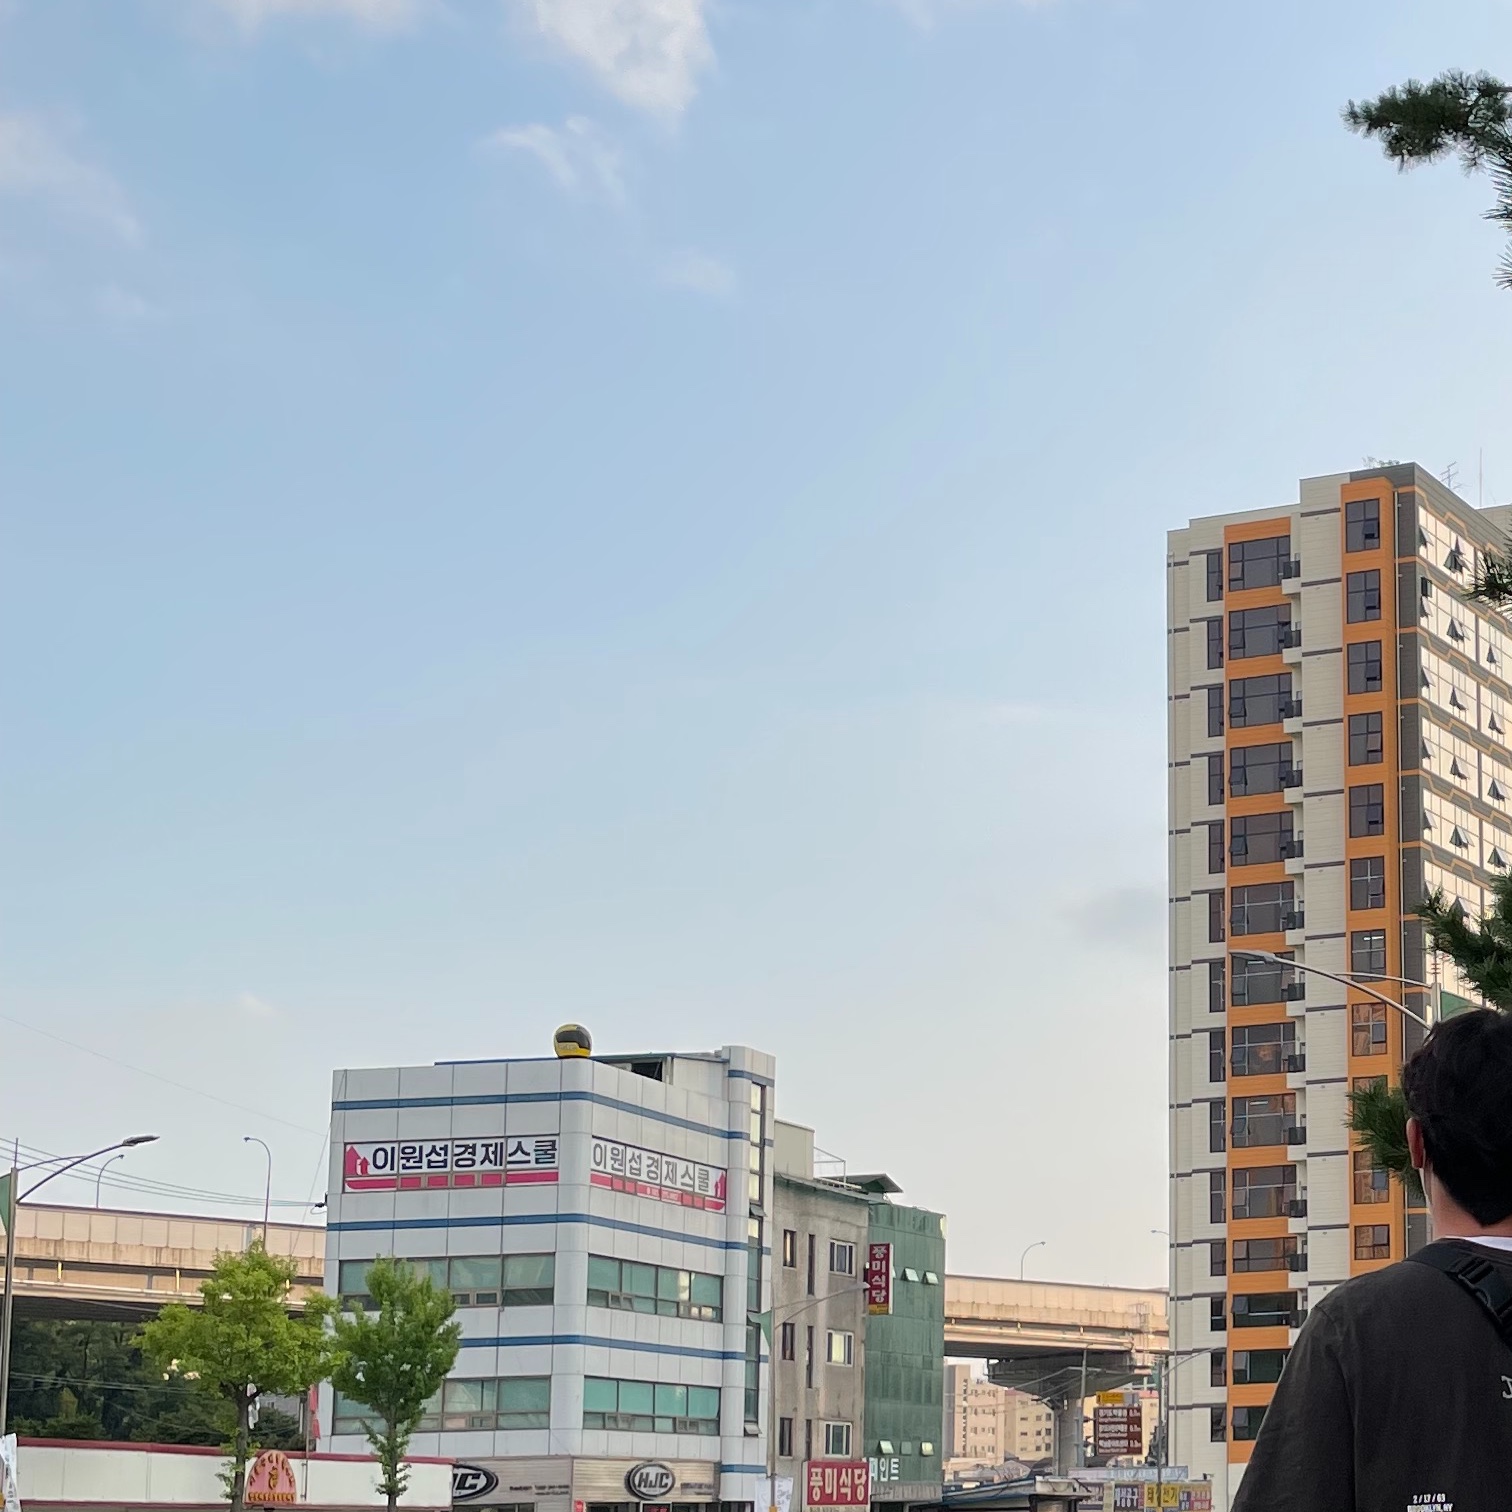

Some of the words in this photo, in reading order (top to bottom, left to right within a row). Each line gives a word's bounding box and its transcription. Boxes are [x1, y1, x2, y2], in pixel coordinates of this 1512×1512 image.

[372, 1138, 558, 1173] 이원섭경제스쿨
[592, 1141, 711, 1193] 이원섭경제스쿨
[871, 1245, 888, 1303] 풍미식당
[637, 1472, 670, 1488] HJC
[810, 1467, 867, 1501] 풍미식당
